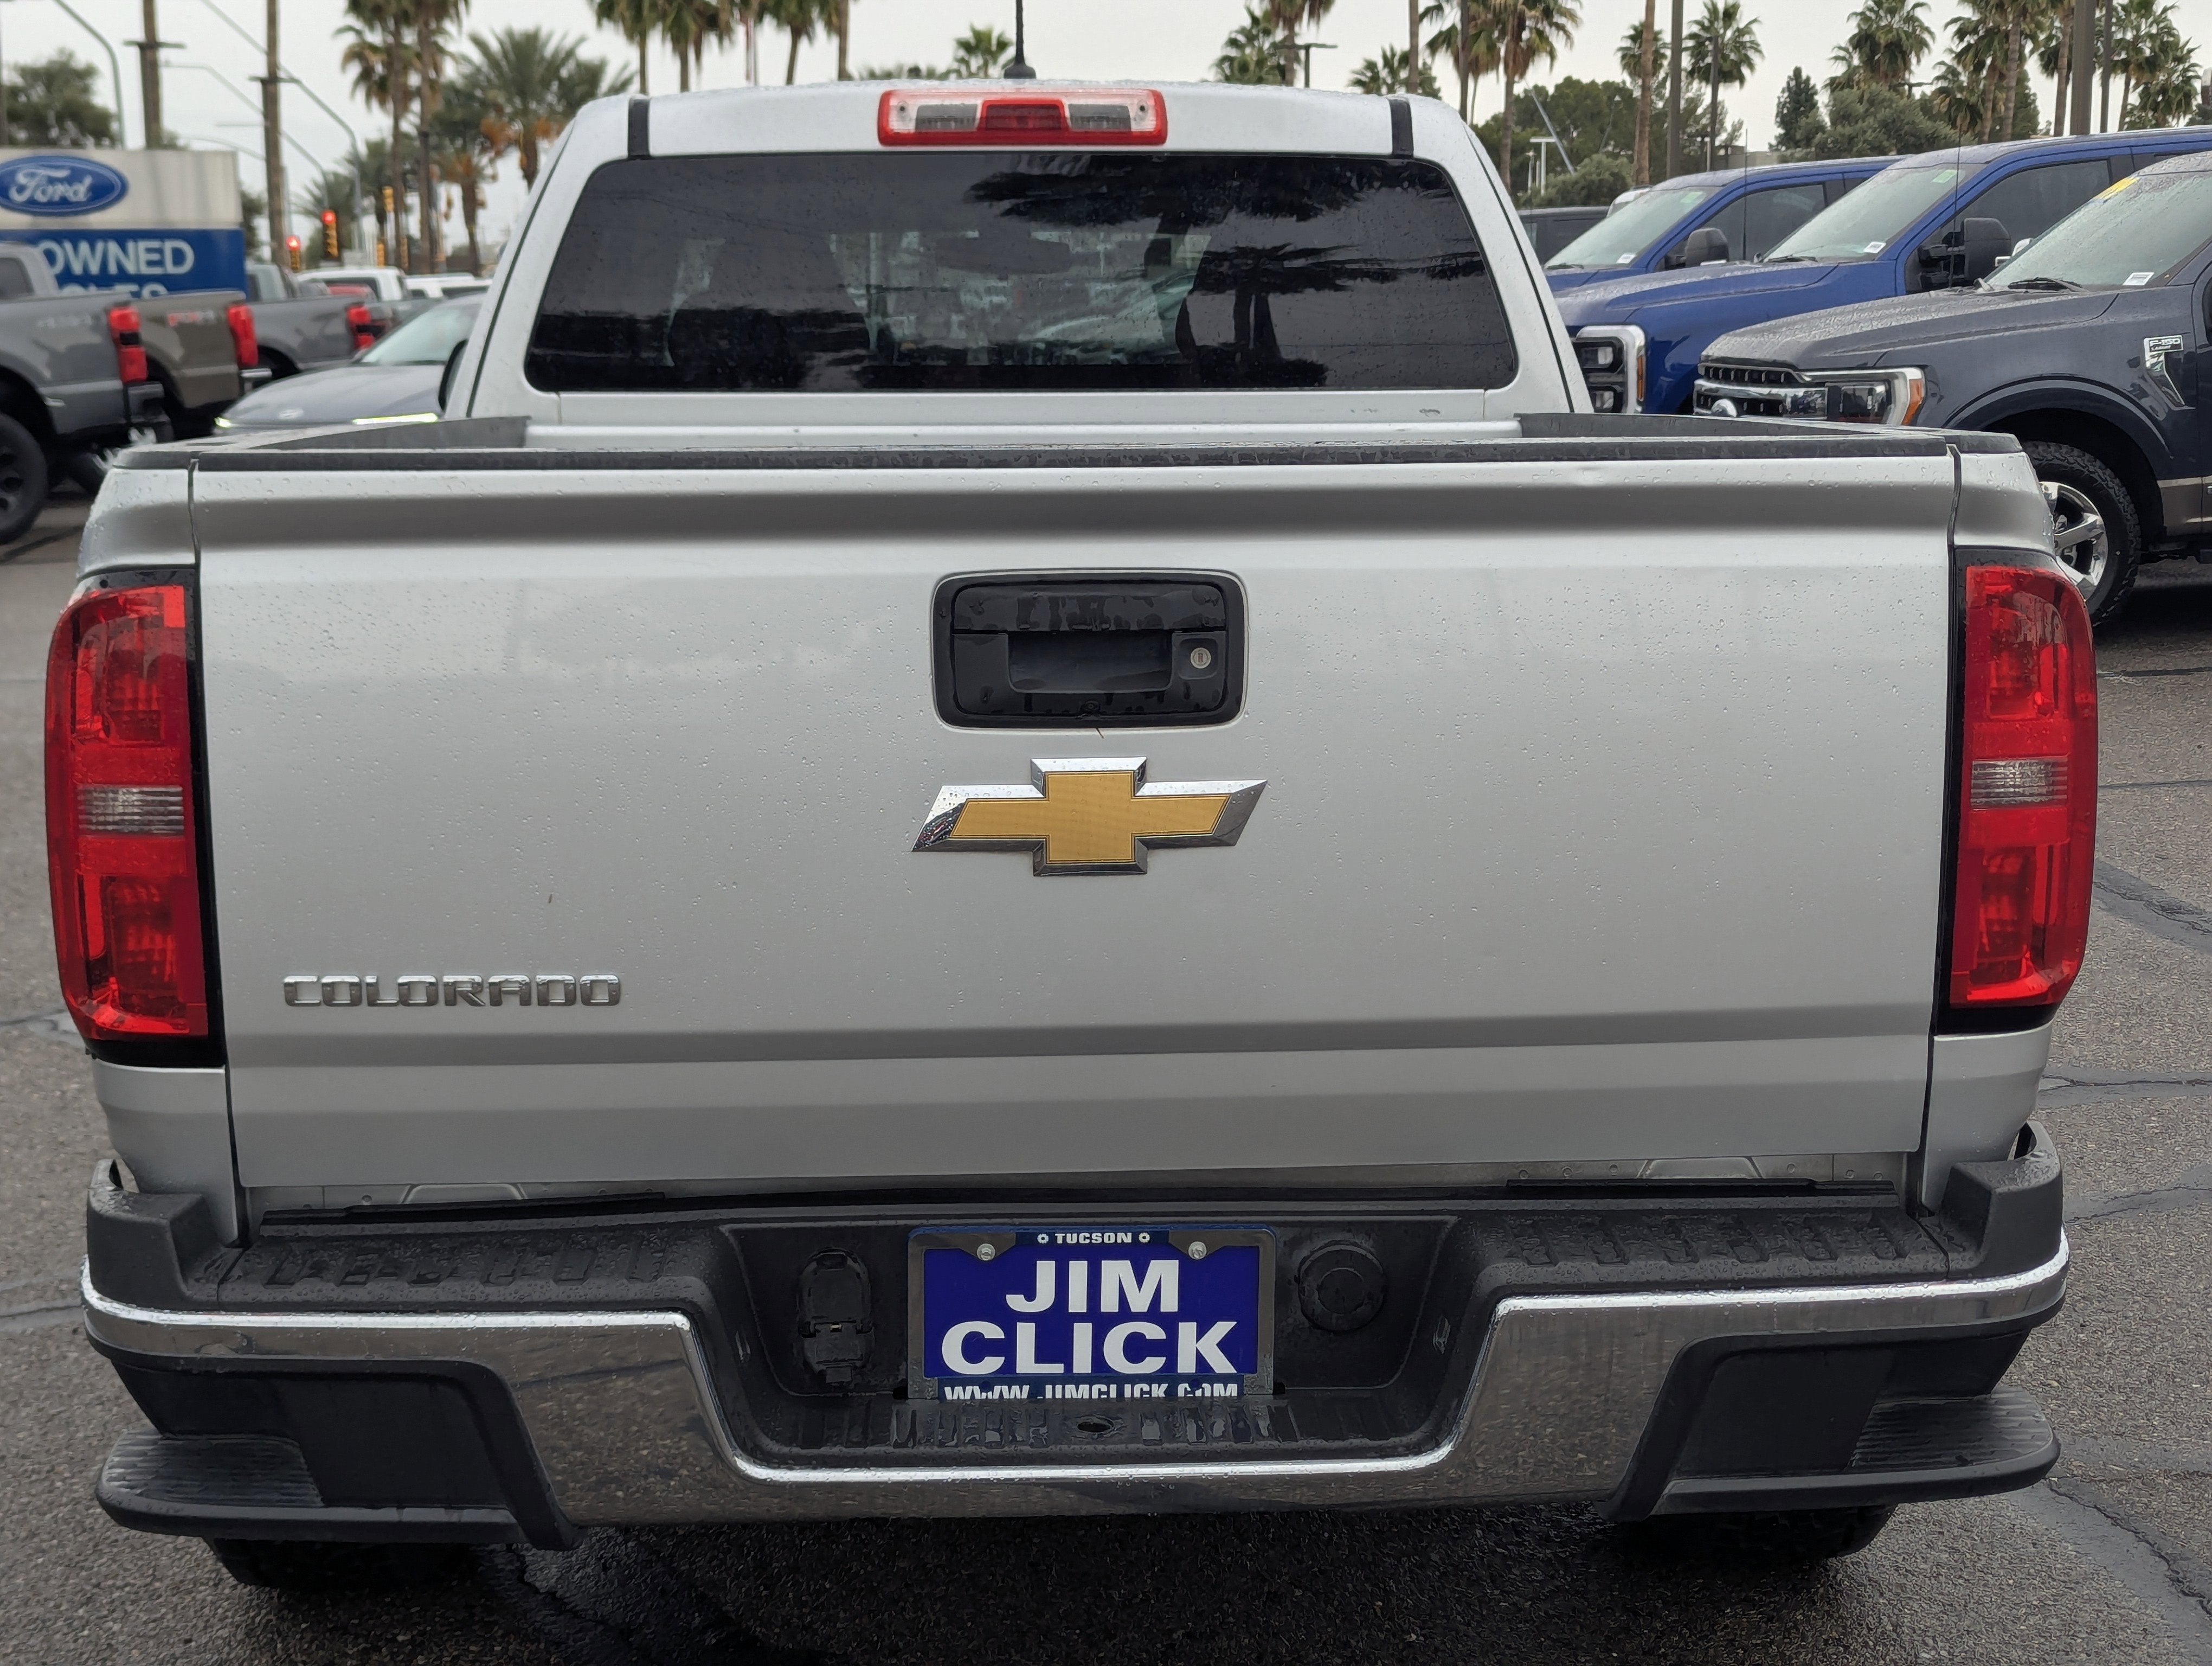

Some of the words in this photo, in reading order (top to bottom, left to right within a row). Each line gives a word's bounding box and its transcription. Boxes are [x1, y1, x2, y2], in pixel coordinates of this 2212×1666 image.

[8, 165, 93, 202] Ford
[284, 975, 621, 1007] COLORADO
[1055, 1233, 1132, 1244] TUCSON
[1006, 1260, 1179, 1312] JIM
[942, 1321, 1237, 1374] CLICK
[944, 1383, 1237, 1399] WWWJIMCLICKCOM
